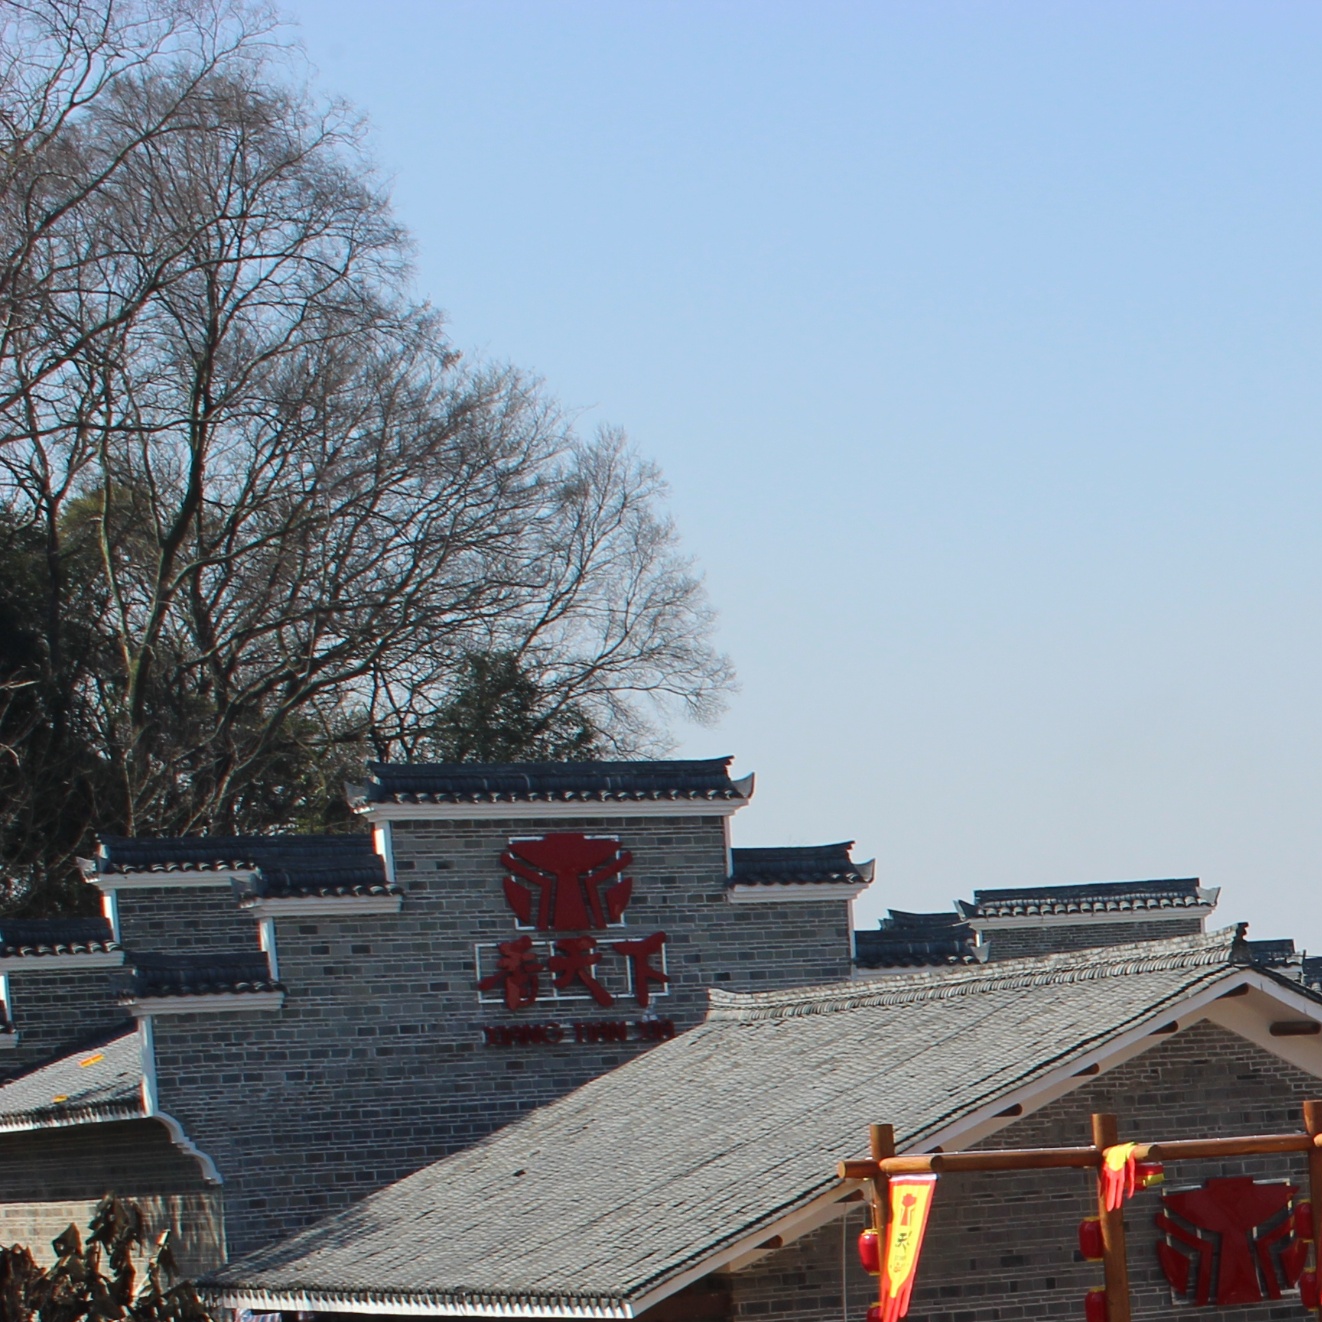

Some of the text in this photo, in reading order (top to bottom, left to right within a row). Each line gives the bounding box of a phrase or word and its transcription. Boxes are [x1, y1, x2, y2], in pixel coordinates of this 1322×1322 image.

[478, 931, 671, 1011] 香天下
[573, 1020, 628, 1043] TIAN
